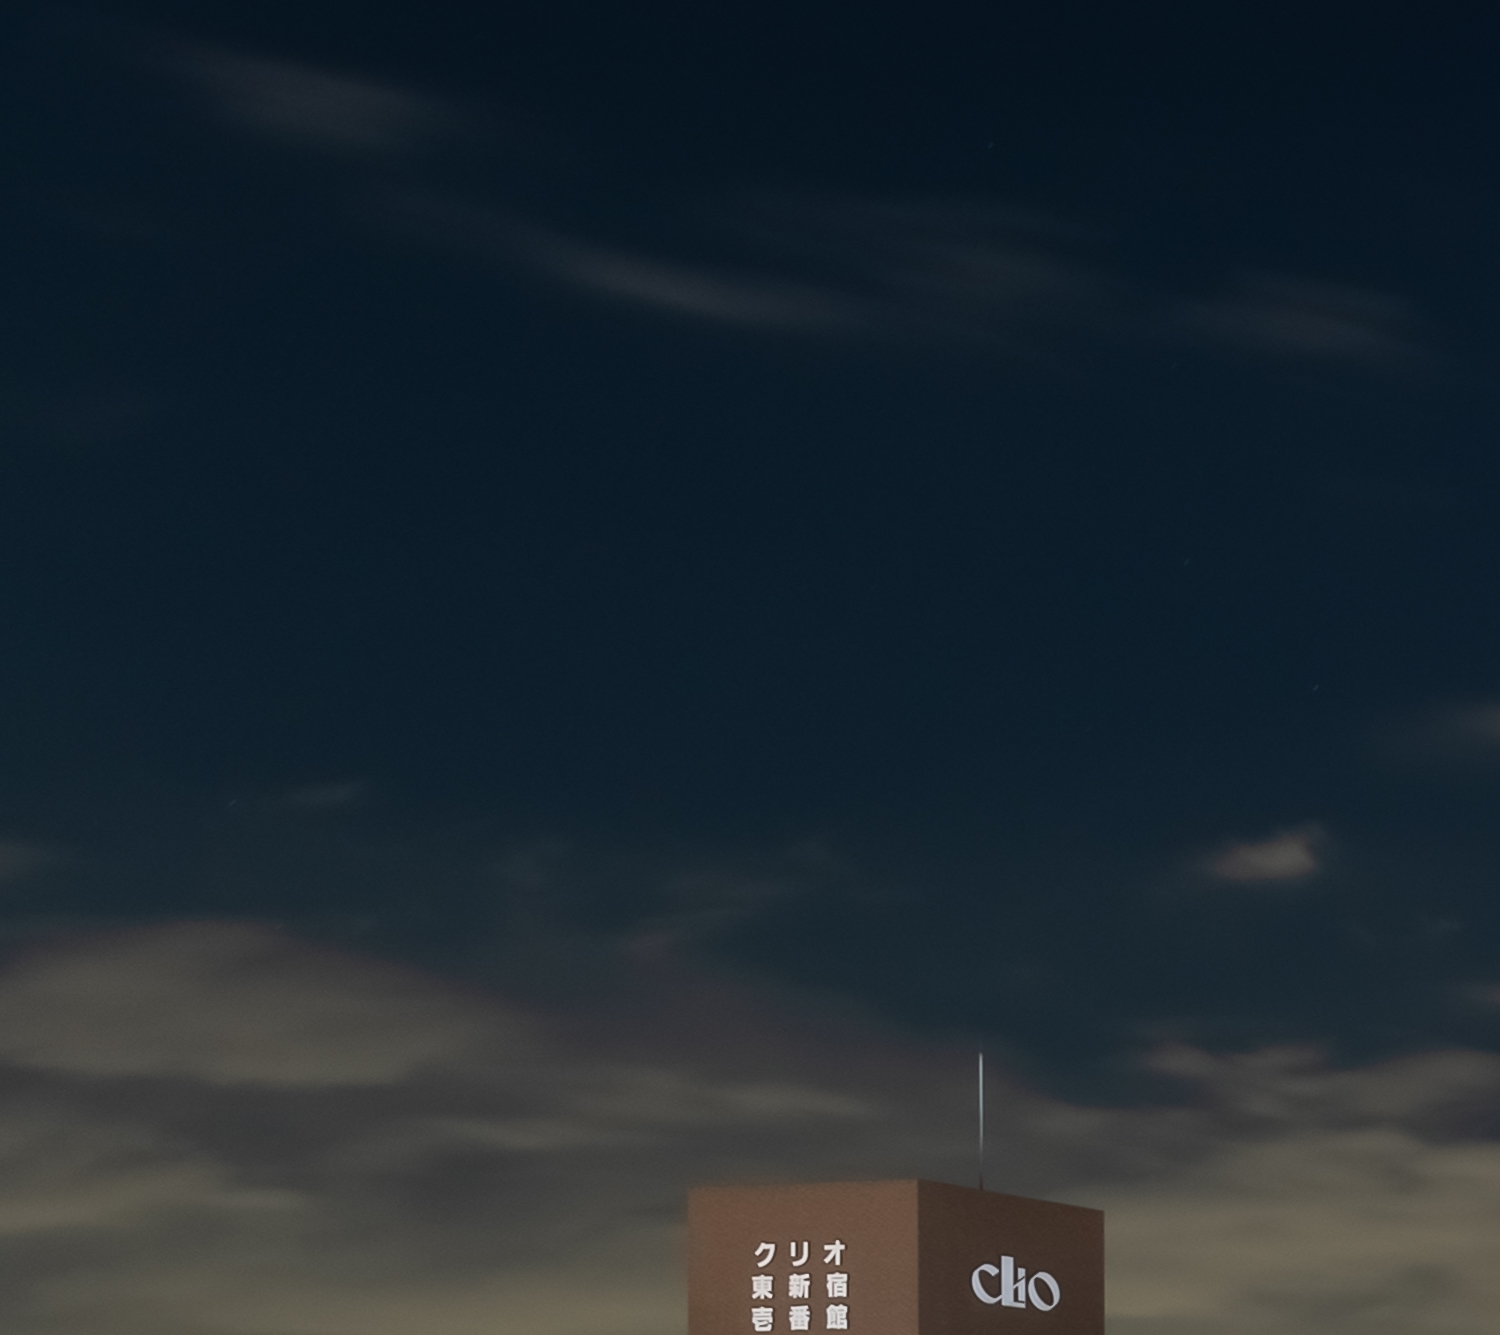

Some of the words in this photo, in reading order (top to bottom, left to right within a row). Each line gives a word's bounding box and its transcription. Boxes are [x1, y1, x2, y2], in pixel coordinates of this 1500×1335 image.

[754, 1239, 846, 1268] クリオ
[751, 1271, 849, 1300] 東新宿
[751, 1303, 849, 1333] 壱番館
